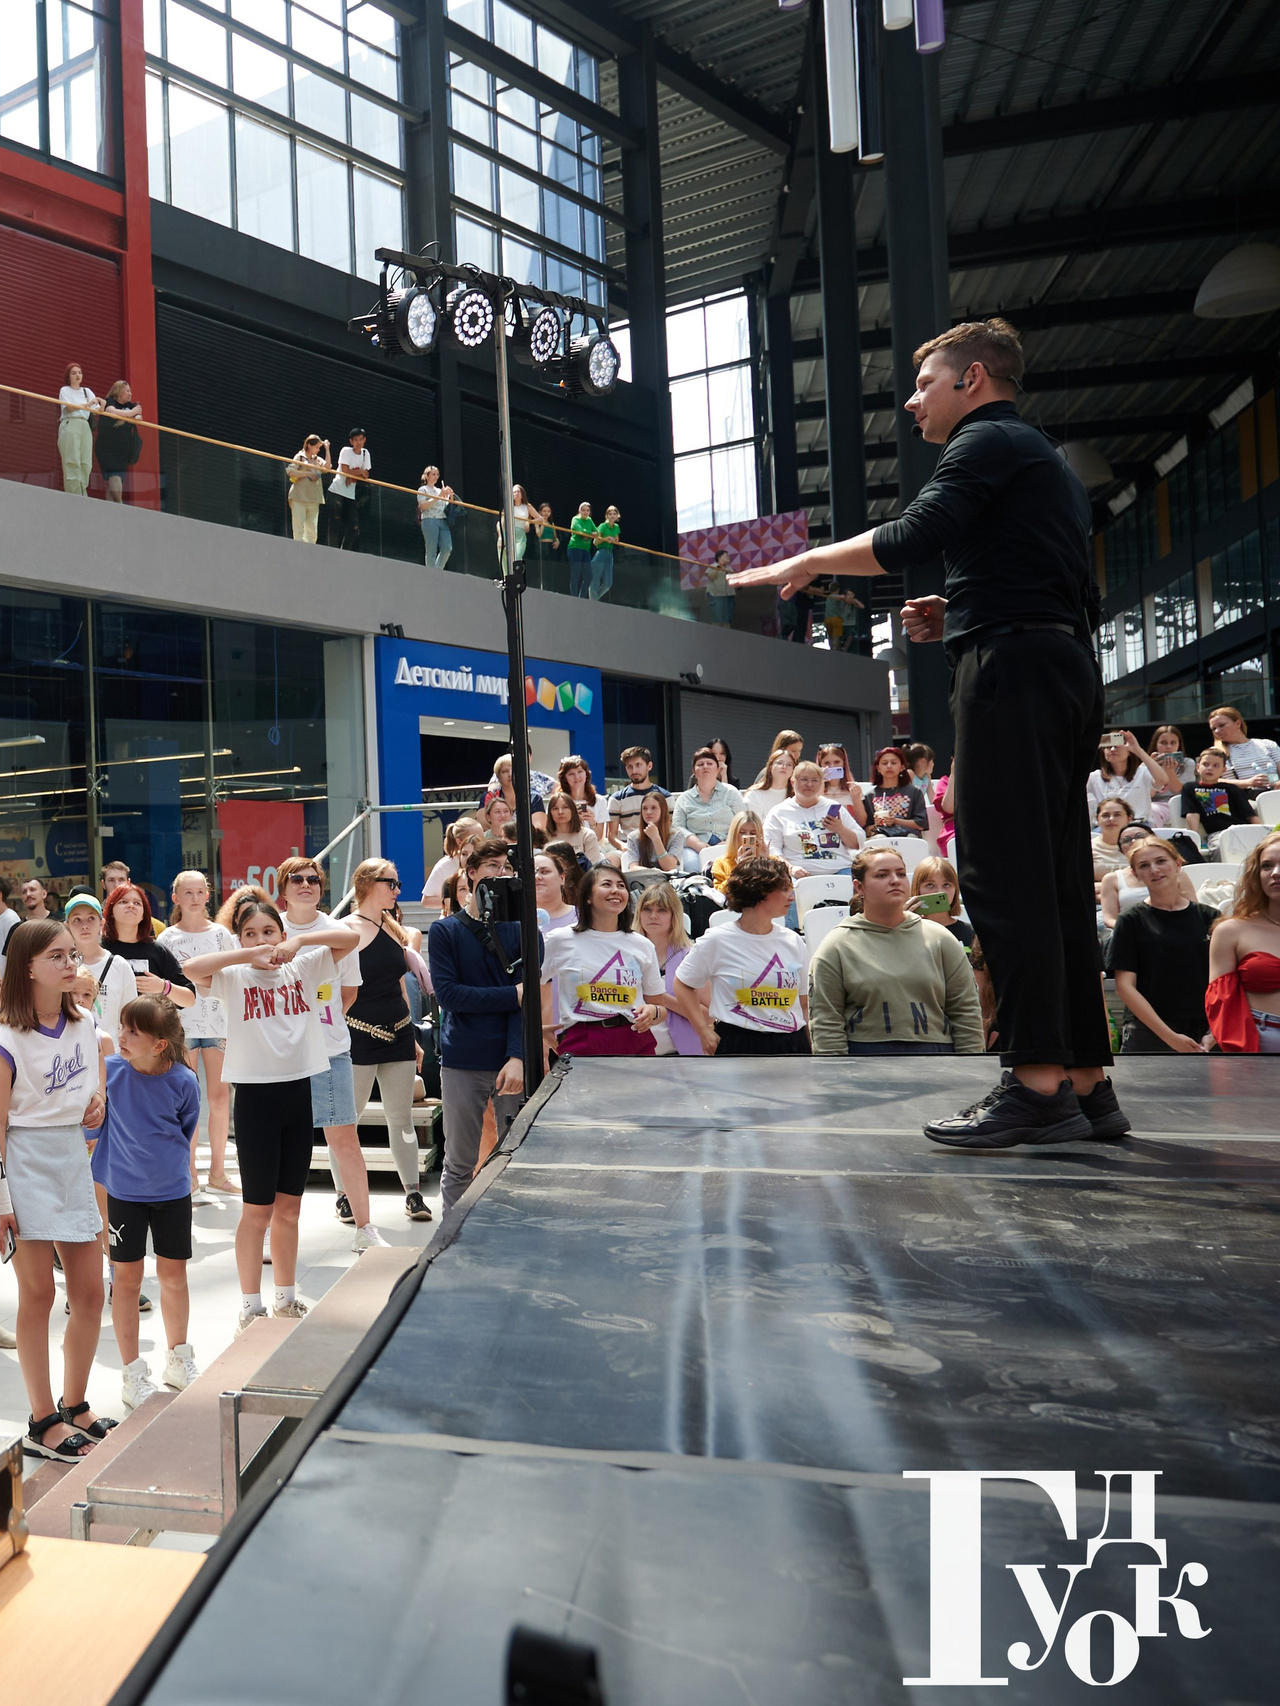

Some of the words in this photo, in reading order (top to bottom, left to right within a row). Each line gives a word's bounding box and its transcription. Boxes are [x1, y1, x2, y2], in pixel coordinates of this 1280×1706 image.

[394, 656, 474, 692] Детский
[475, 674, 510, 705] мир
[590, 985, 618, 993] Dance
[750, 989, 779, 998] Dance
[590, 993, 629, 1003] BATTLE
[751, 997, 790, 1006] BATTLE
[43, 1042, 88, 1096] Level
